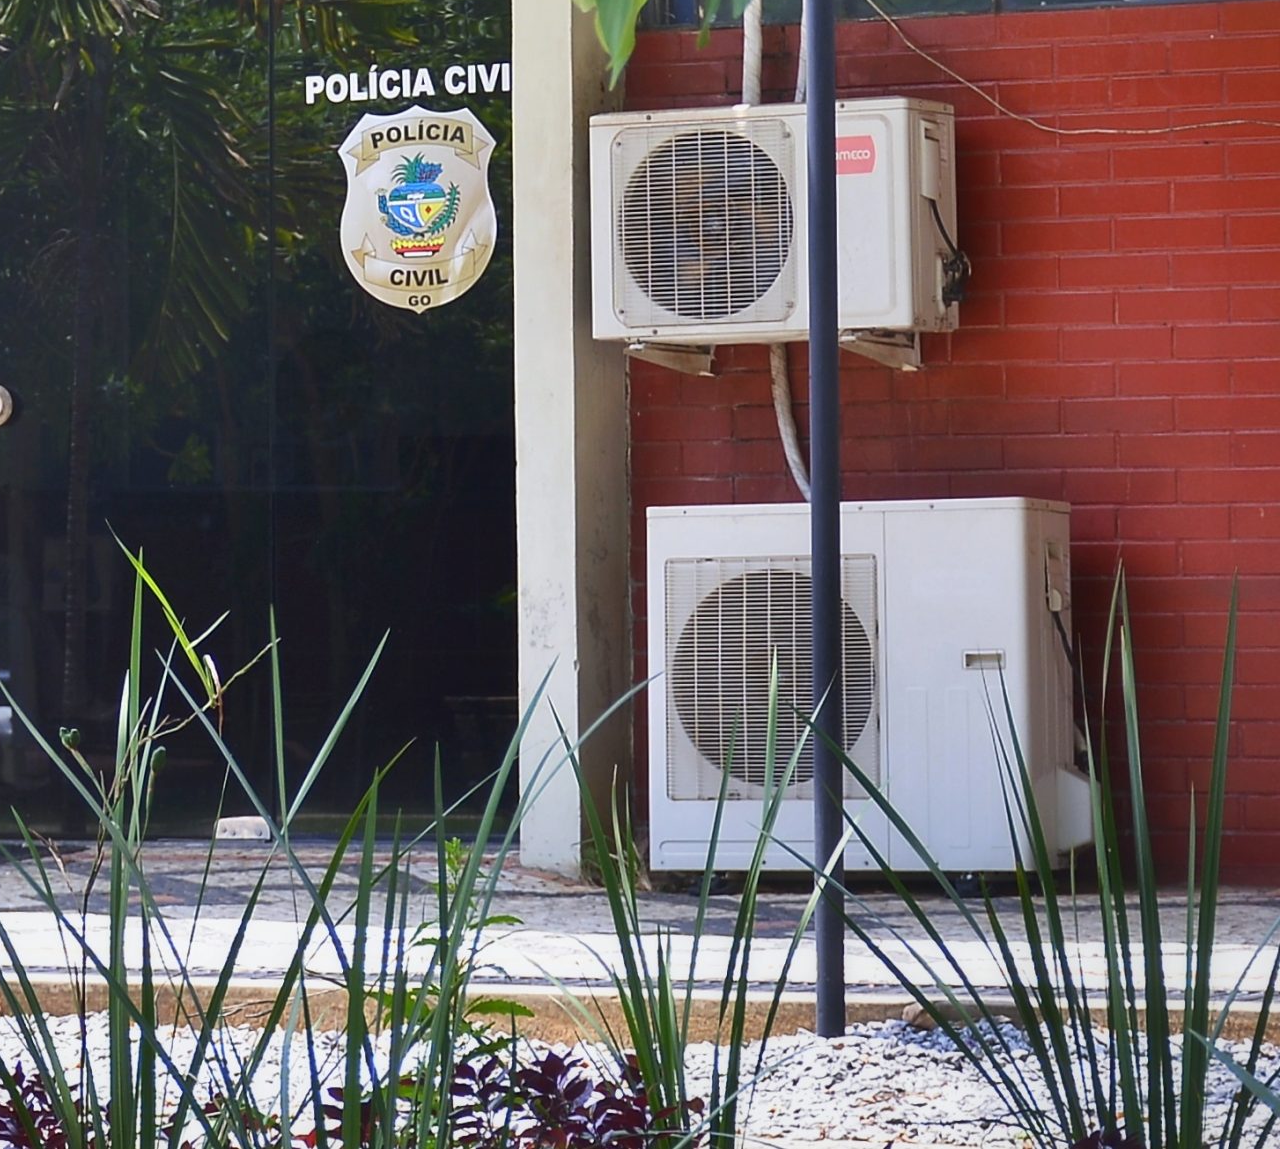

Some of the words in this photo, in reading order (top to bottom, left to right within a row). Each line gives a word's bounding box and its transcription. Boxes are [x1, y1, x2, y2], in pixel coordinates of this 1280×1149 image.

[305, 64, 436, 104] POLÍCIA
[444, 62, 511, 95] CIVI
[370, 120, 466, 149] POLÍCIA
[389, 268, 449, 287] CIVIL
[408, 295, 432, 307] GO
